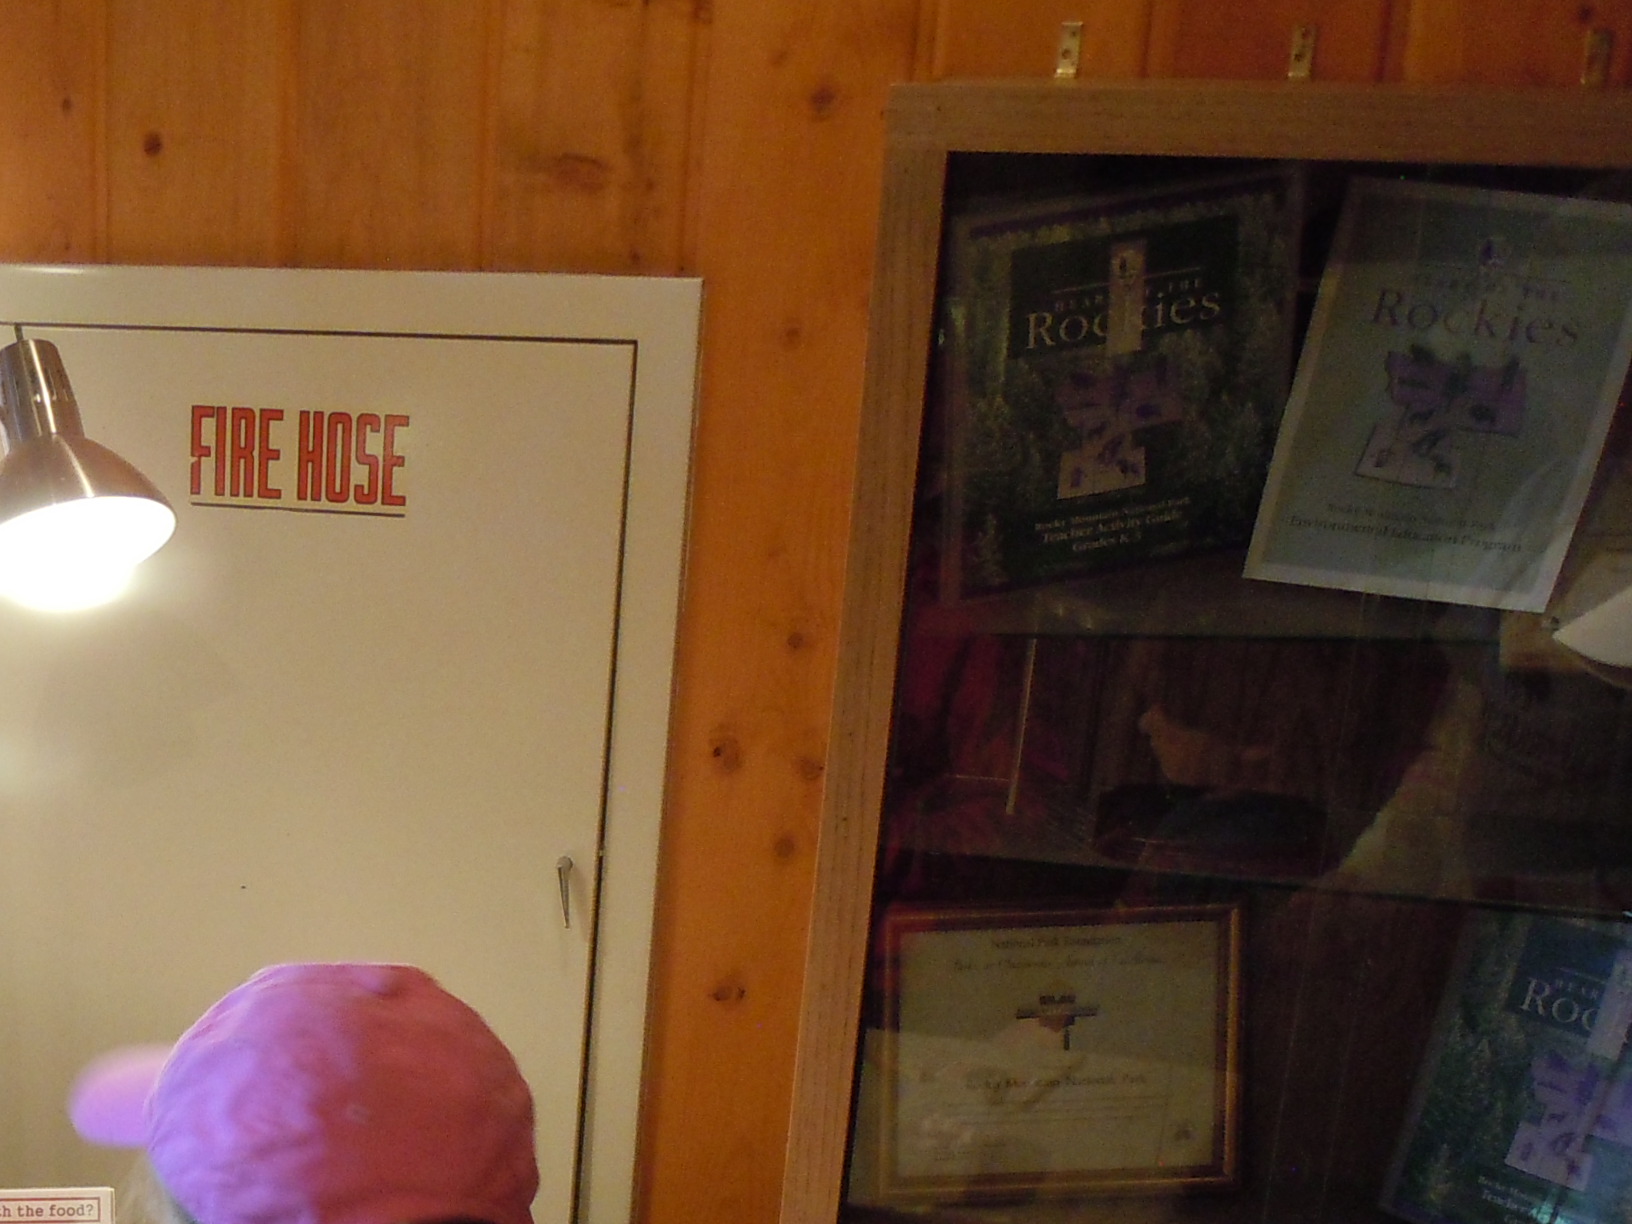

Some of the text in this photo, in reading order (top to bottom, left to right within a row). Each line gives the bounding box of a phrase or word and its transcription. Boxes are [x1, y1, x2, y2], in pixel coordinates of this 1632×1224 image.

[190, 404, 410, 507] FIRE HOSE
[17, 1204, 44, 1217] the
[48, 1203, 95, 1217] food?
